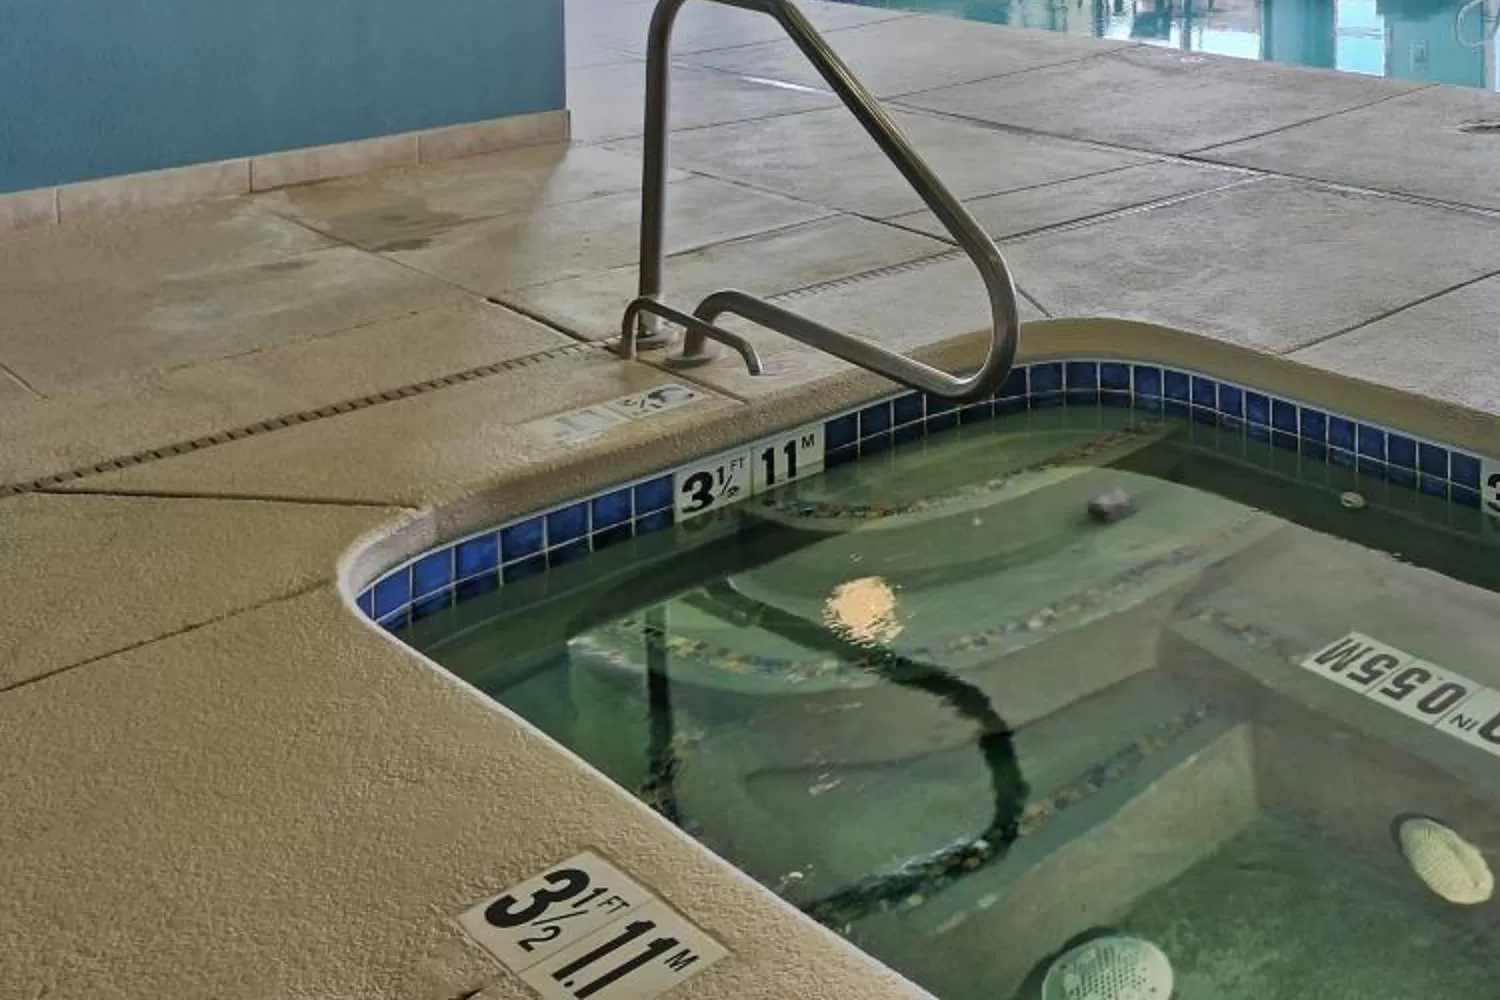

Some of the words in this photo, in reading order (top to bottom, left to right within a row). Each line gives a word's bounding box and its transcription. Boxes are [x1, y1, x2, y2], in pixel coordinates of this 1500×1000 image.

[801, 433, 815, 449] M
[730, 456, 745, 471] FT
[1449, 713, 1480, 732] IN
[597, 894, 631, 914] FT
[663, 948, 700, 973] M
